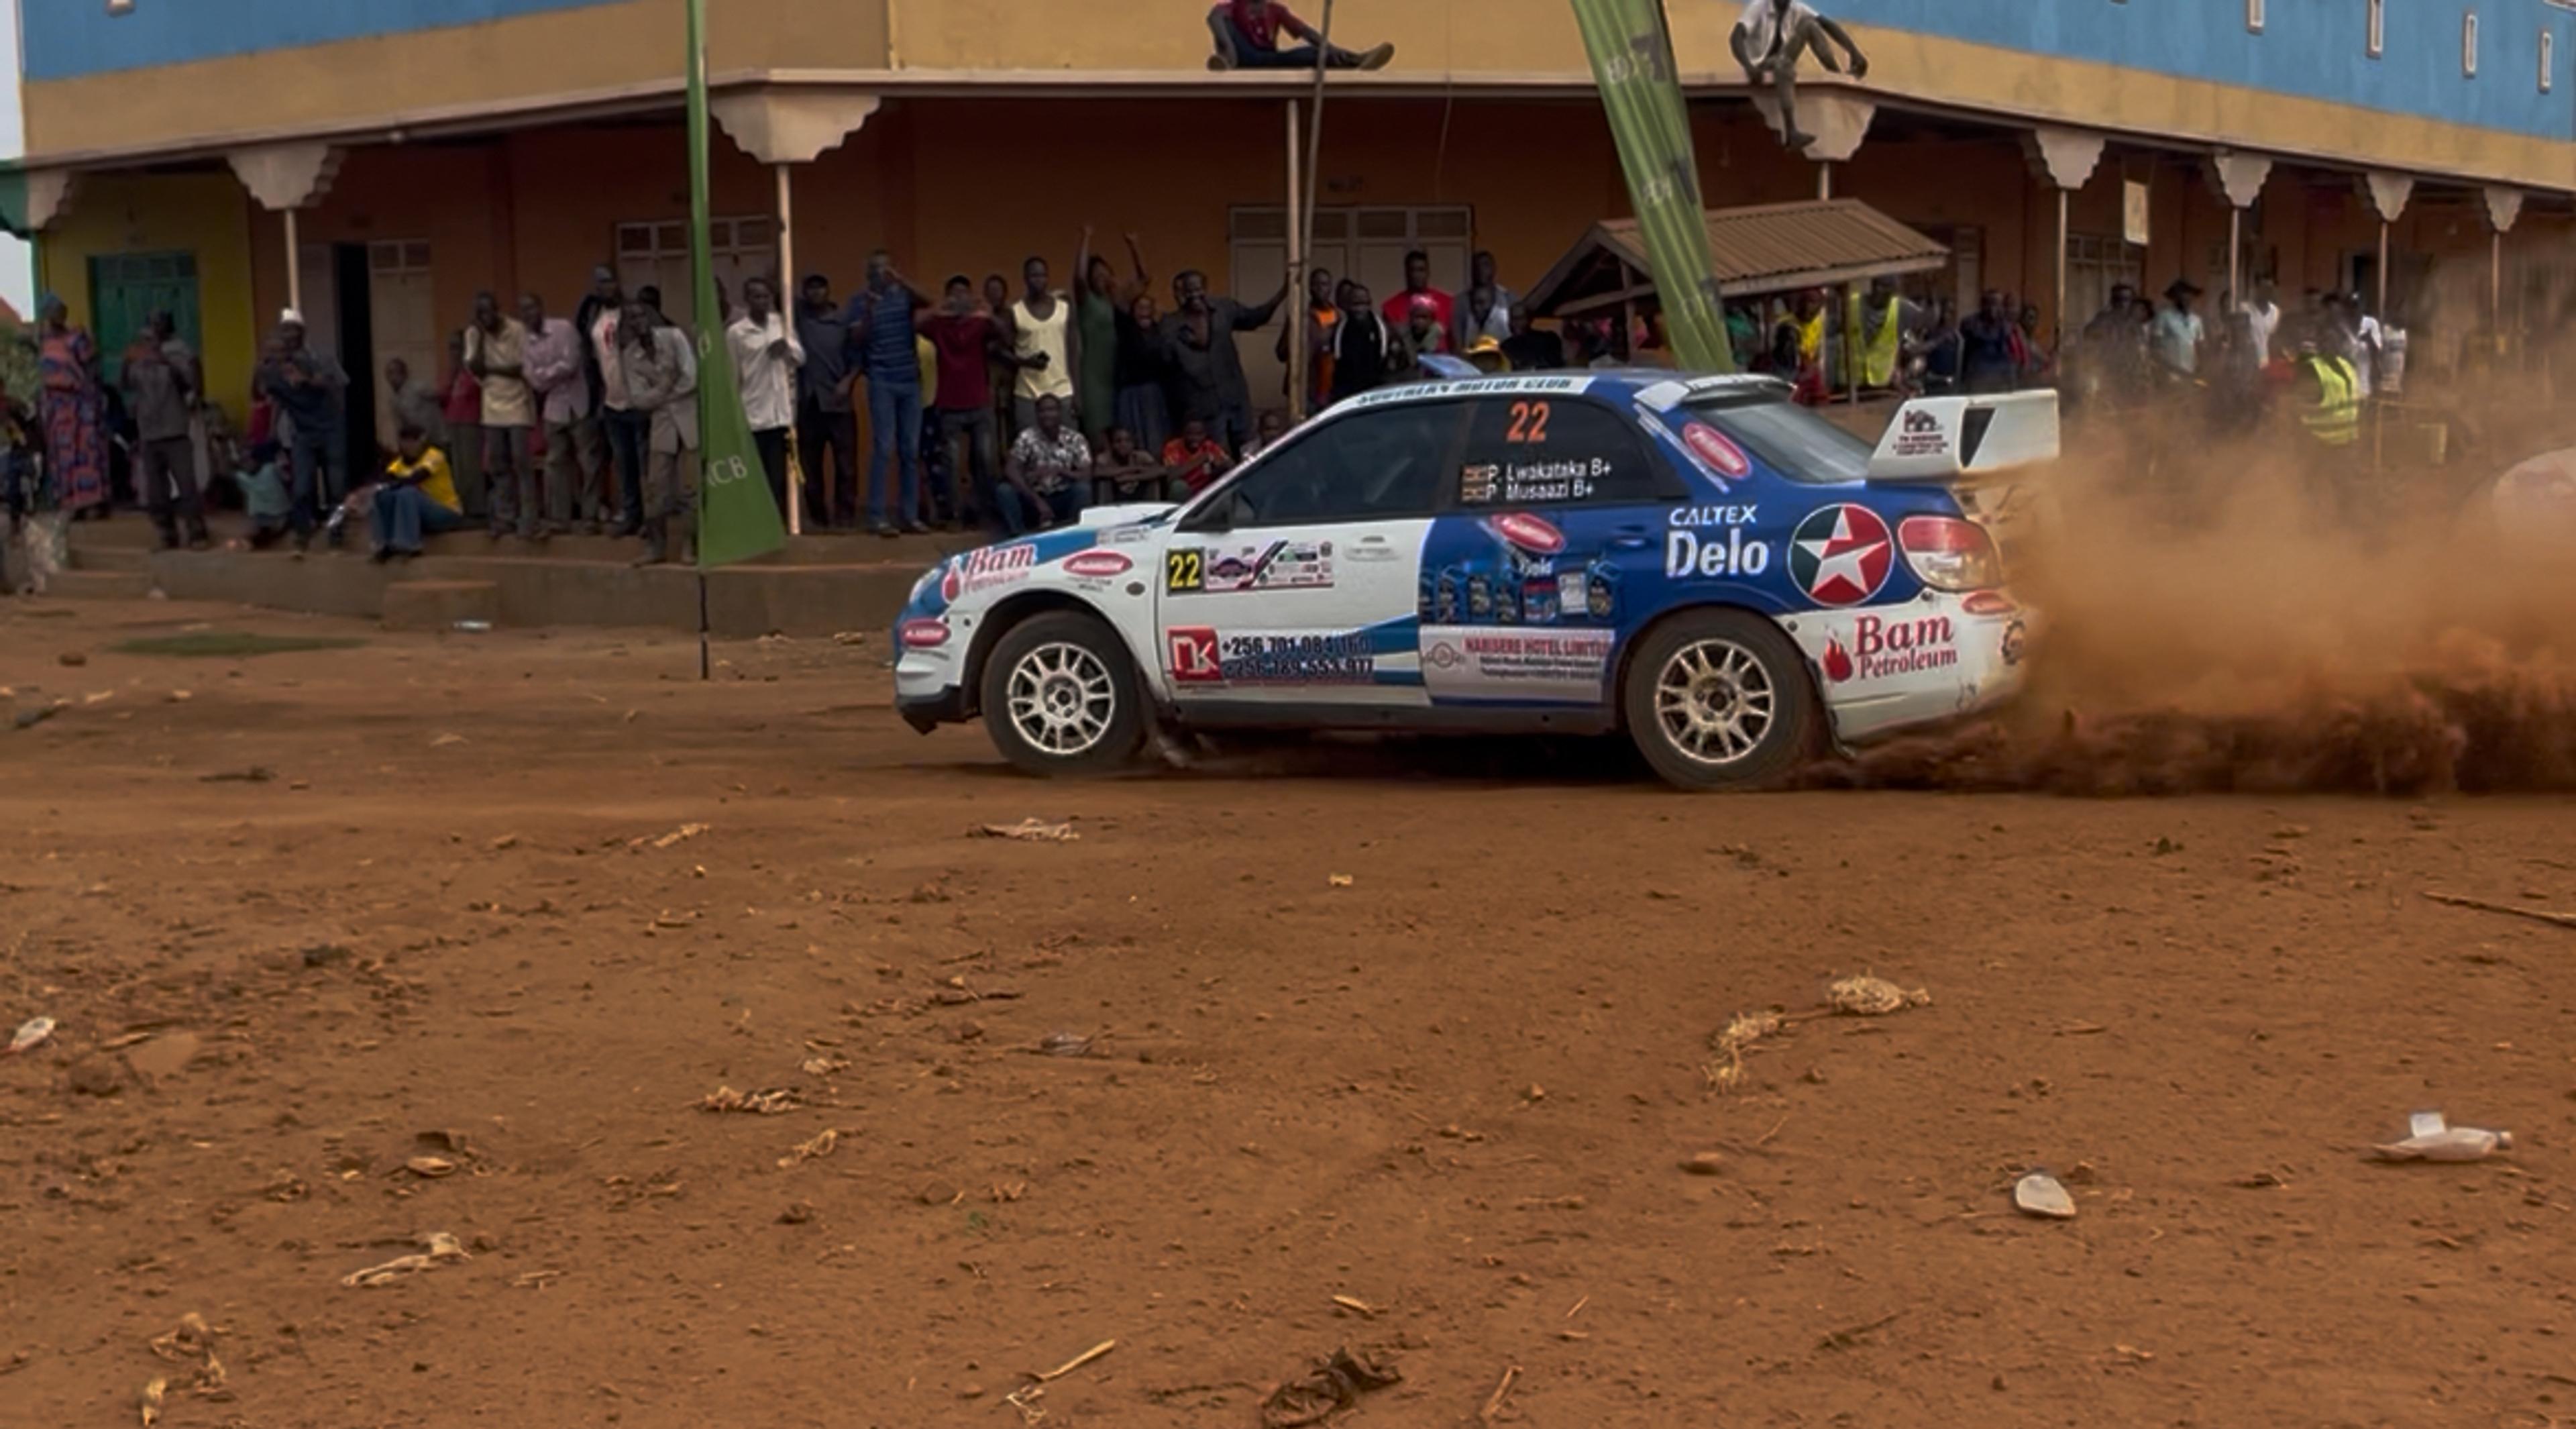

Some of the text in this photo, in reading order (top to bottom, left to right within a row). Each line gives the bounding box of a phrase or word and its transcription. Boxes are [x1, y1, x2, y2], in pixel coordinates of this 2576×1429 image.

[1523, 378, 1572, 390] CLUB
[1506, 401, 1551, 443] 22
[1668, 504, 1758, 526] CALTEX
[968, 543, 1037, 574] Bam
[1169, 552, 1199, 588] 22
[1666, 527, 1769, 579] Delo
[1855, 614, 1954, 657] Bam
[1858, 647, 1958, 680] Petroleum
